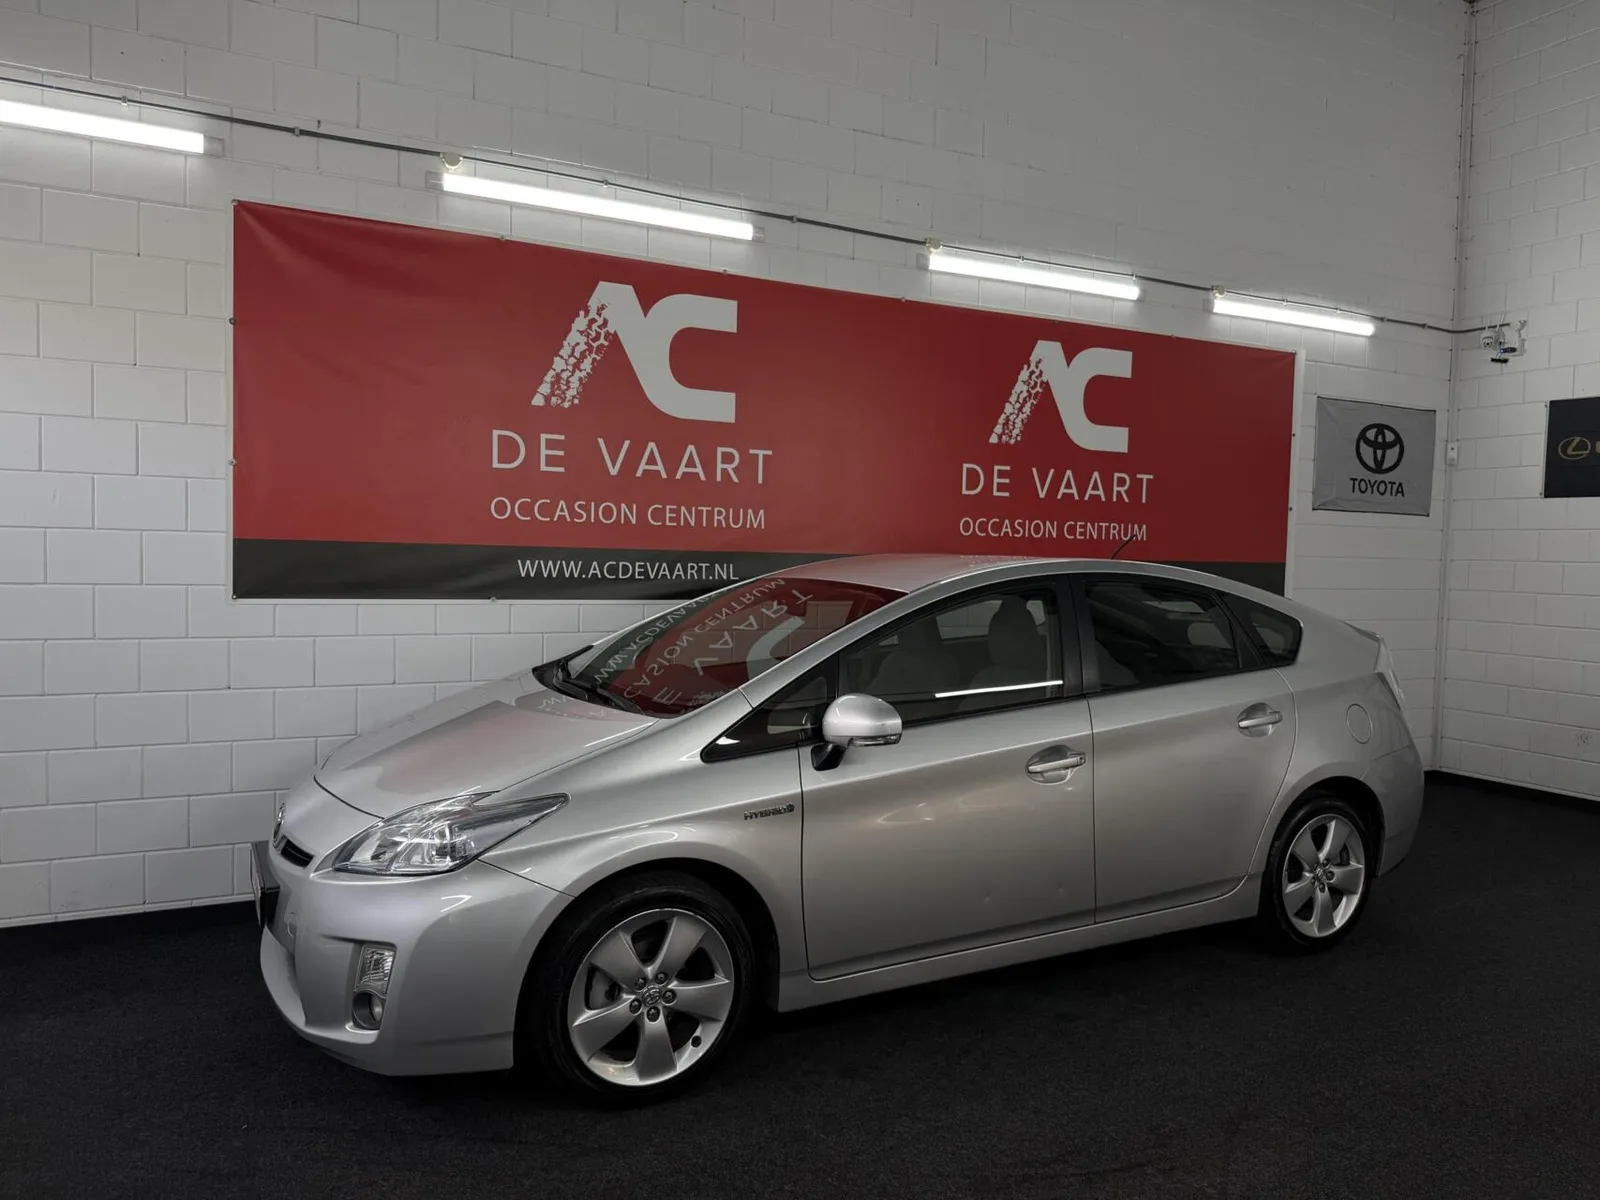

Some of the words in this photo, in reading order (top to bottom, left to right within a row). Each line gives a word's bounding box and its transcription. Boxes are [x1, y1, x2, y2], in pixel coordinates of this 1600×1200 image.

[492, 429, 565, 473] DE
[597, 437, 773, 484] VAART
[961, 463, 1011, 497] DE
[1032, 467, 1154, 503] VAART
[1350, 477, 1405, 498] TOYOTA
[490, 497, 637, 525] OCCASION
[647, 504, 765, 529] CENTRUM
[959, 517, 1057, 539] OCCASION
[1063, 521, 1147, 541] CENTRUM
[517, 559, 739, 581] WWW.ACDEVAART.NL
